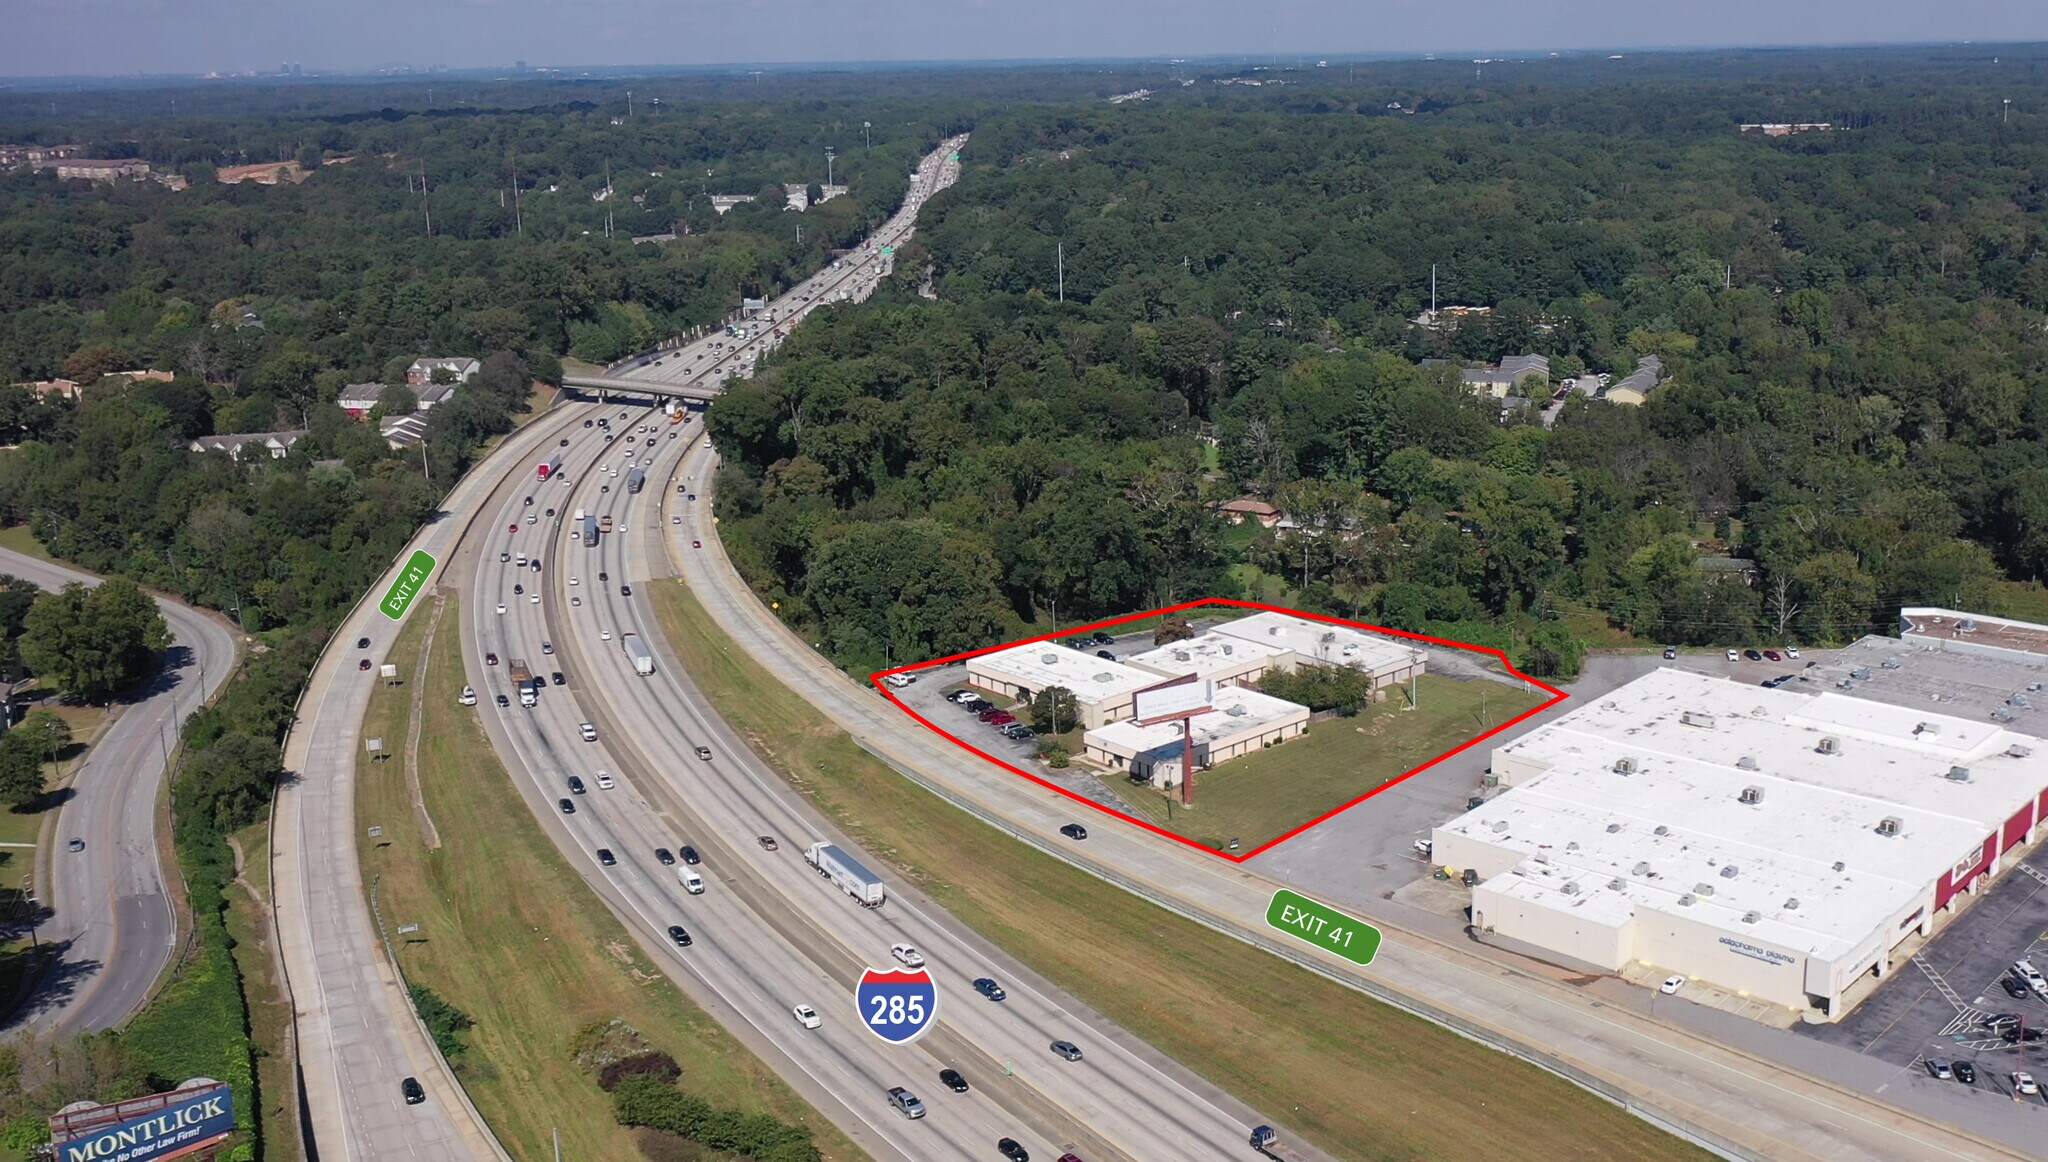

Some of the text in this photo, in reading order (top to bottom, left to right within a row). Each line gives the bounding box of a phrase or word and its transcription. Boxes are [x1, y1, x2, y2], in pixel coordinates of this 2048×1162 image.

[68, 1096, 226, 1162] MONTLICK
[131, 1143, 156, 1158] Other
[157, 1136, 176, 1149] Law
